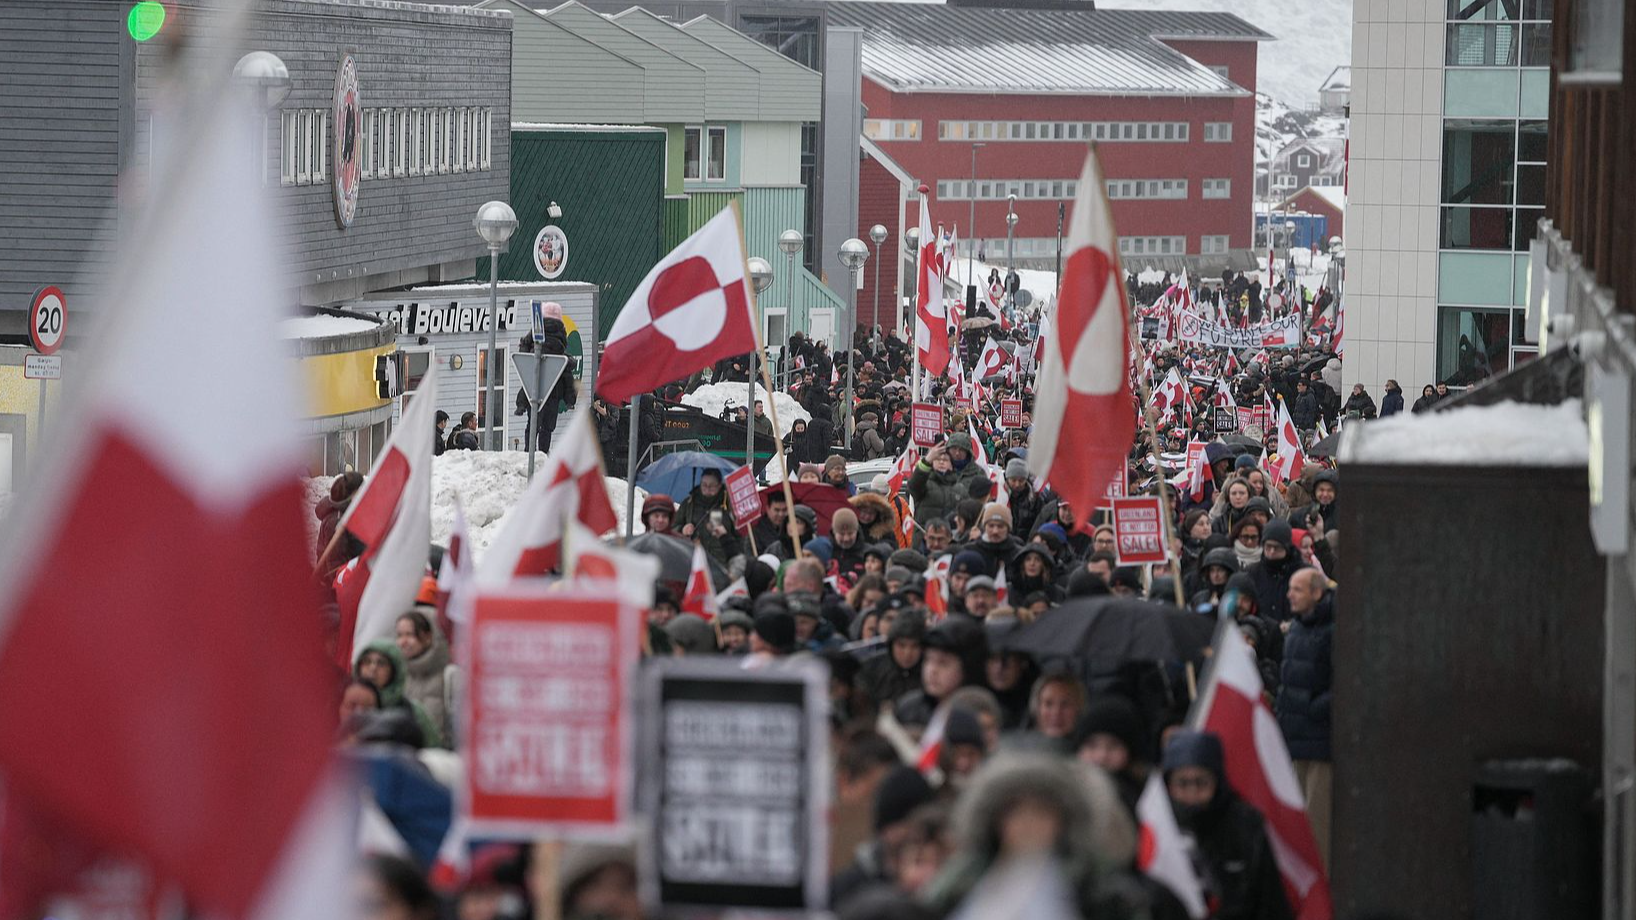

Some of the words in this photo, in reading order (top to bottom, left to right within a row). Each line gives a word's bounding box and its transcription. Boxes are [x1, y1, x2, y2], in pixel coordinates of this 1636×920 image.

[38, 306, 61, 334] 20
[415, 300, 518, 333] Boulevard
[1271, 315, 1298, 331] OUR
[1199, 328, 1260, 346] FUTURE
[916, 429, 938, 443] SALE
[1122, 536, 1159, 553] SALE!
